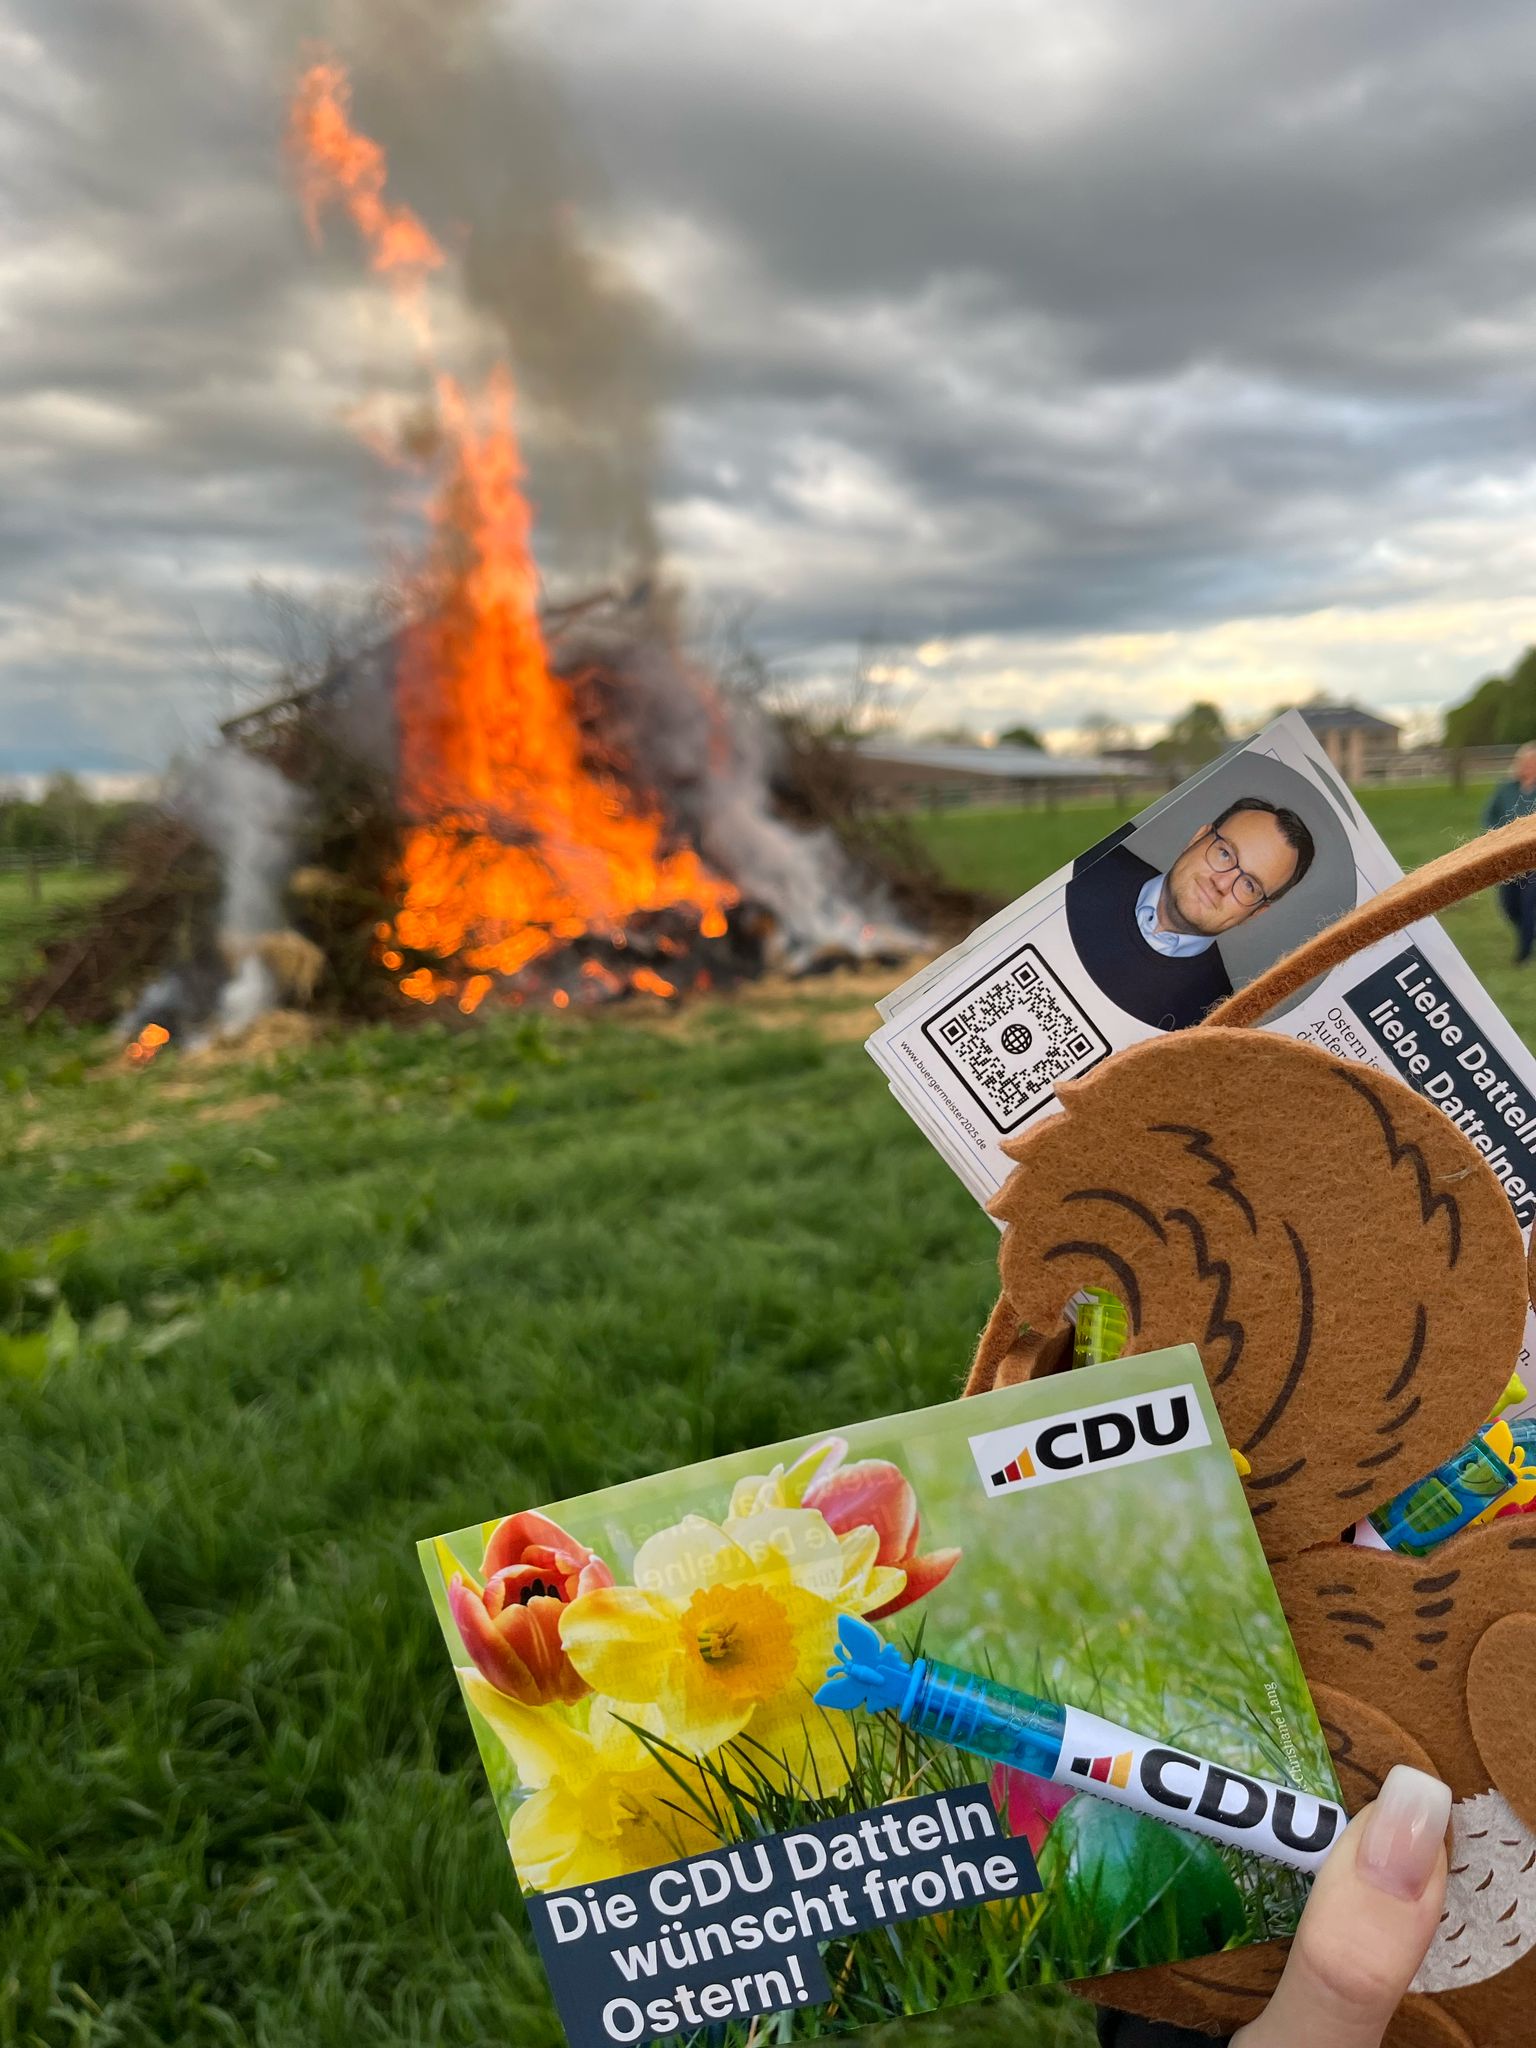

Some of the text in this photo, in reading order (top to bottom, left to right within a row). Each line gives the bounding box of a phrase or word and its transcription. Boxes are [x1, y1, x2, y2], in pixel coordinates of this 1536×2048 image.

[1327, 1007, 1367, 1059] Ostern
[1368, 998, 1431, 1075] liebe
[1394, 961, 1463, 1047] Liebe
[900, 1041, 987, 1151] www.buergermeister2025.de
[1035, 1395, 1190, 1471] CDU
[1264, 1681, 1283, 1715] Lang
[1276, 1716, 1304, 1785] Christiane
[1139, 1748, 1338, 1853] CDU
[545, 1887, 638, 1944] Die
[649, 1844, 774, 1916] CDU
[782, 1797, 997, 1881] Datteln
[610, 1853, 1020, 1982] wünscht frohe
[601, 1954, 809, 2043] Ostern!
